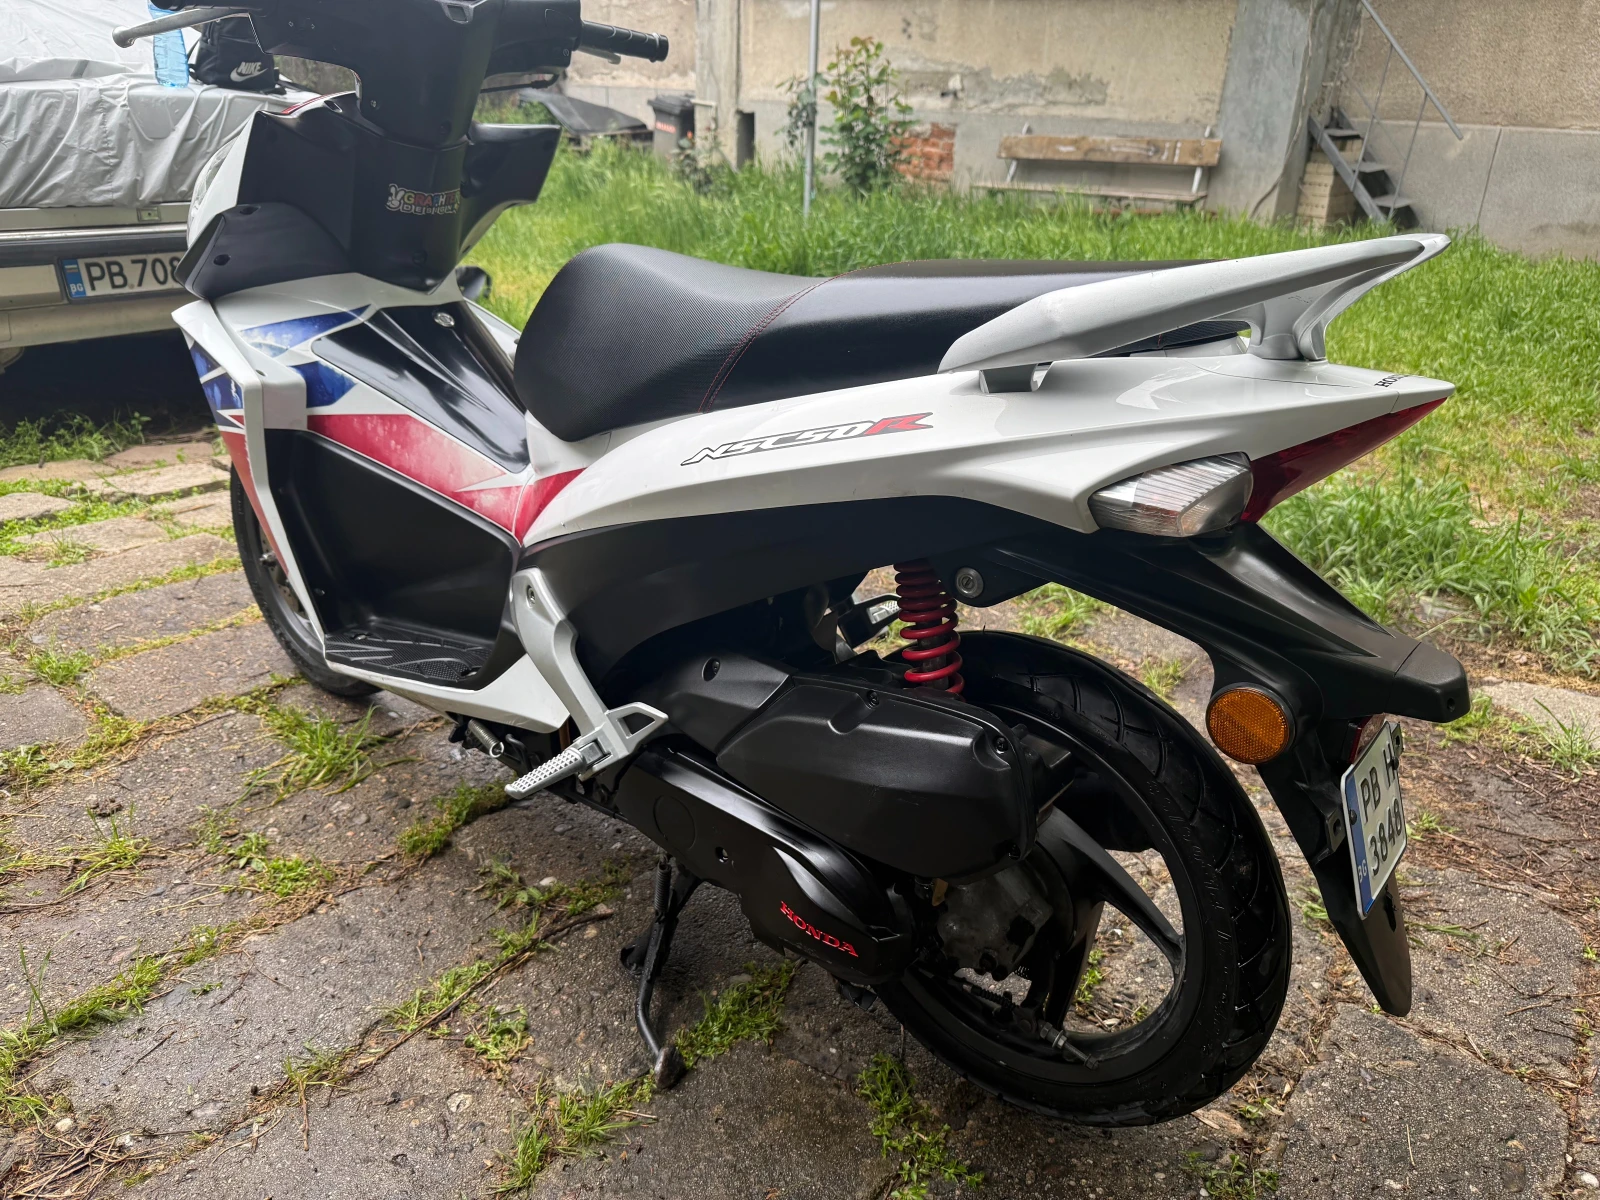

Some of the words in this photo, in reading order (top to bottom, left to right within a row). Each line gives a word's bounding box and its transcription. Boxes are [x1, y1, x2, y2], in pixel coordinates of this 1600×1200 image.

[237, 61, 262, 75] NIKE
[69, 283, 84, 295] BG
[84, 260, 128, 291] PB
[680, 412, 933, 466] NSC50R
[1360, 766, 1382, 825] PB
[1368, 797, 1402, 877] 3848
[1357, 860, 1368, 884] BG
[780, 900, 859, 958] HONDA
